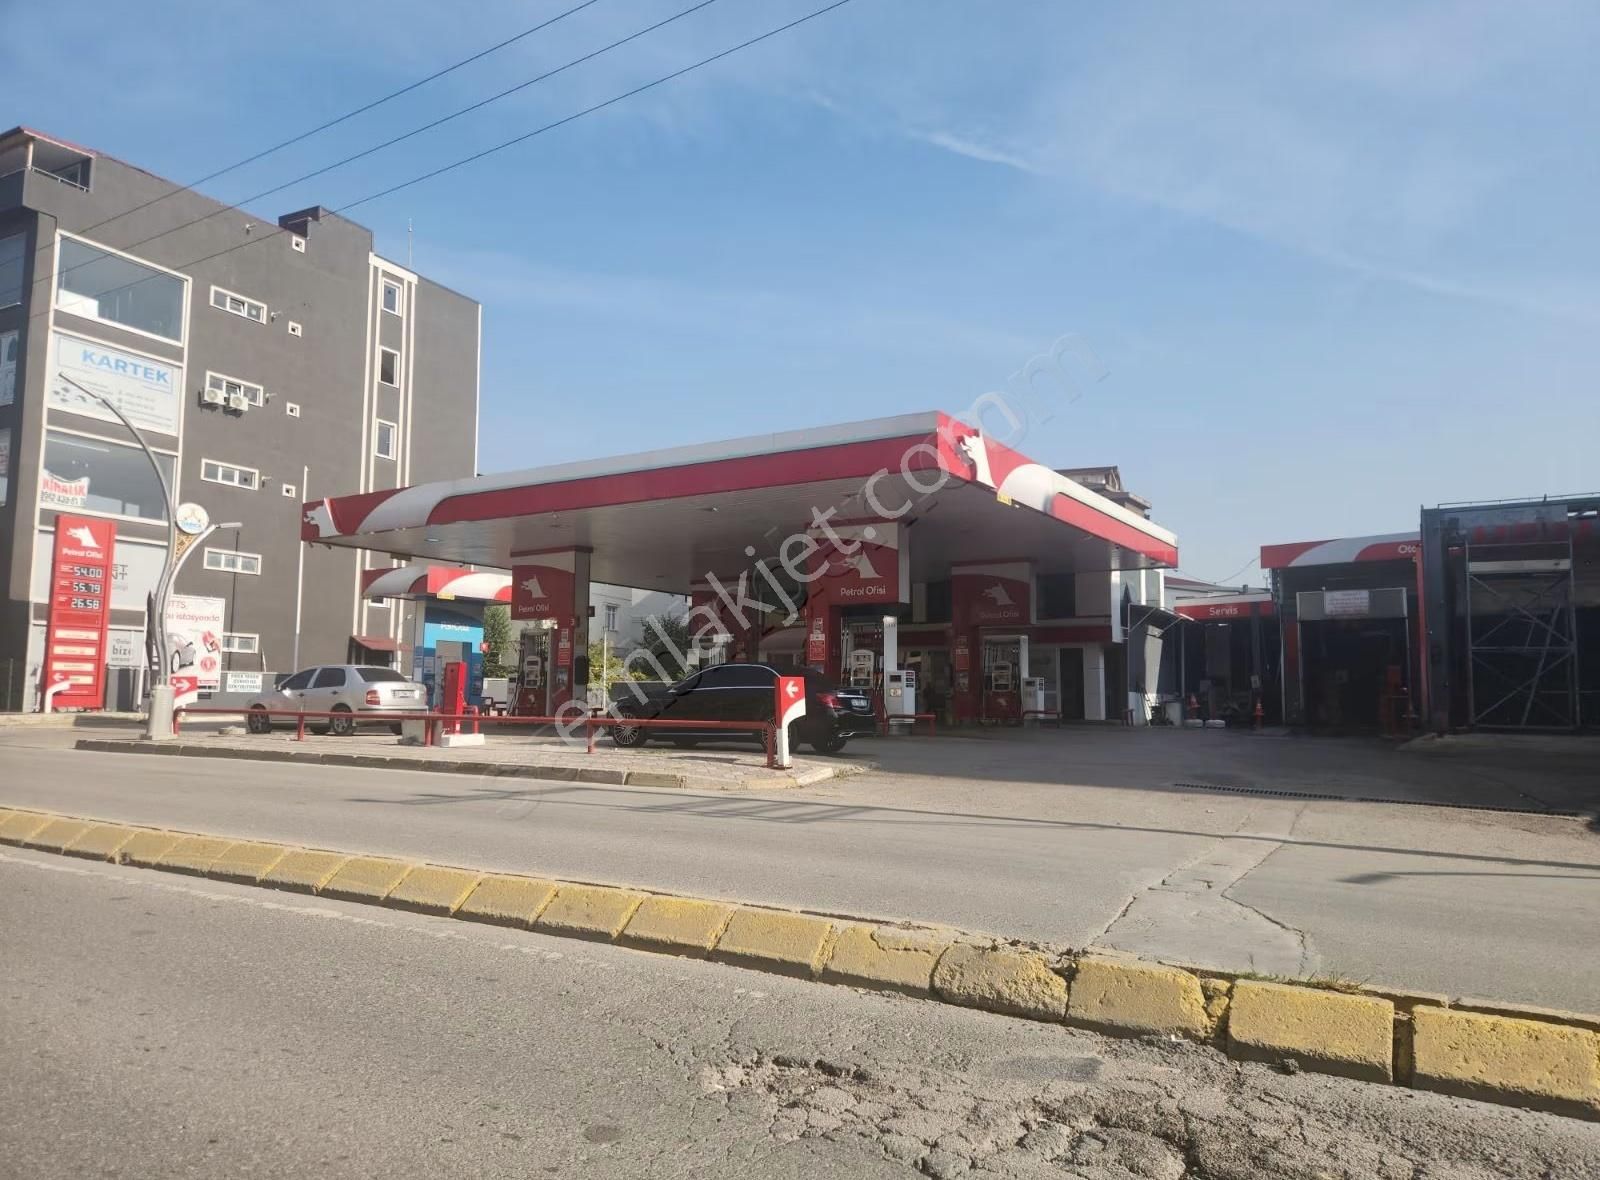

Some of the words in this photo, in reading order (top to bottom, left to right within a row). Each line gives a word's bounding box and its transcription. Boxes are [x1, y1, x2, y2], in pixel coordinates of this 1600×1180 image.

[81, 349, 169, 383] KARTEK
[840, 587, 864, 597] Petrol
[866, 585, 886, 595] Ofisi
[1209, 607, 1239, 617] Servis
